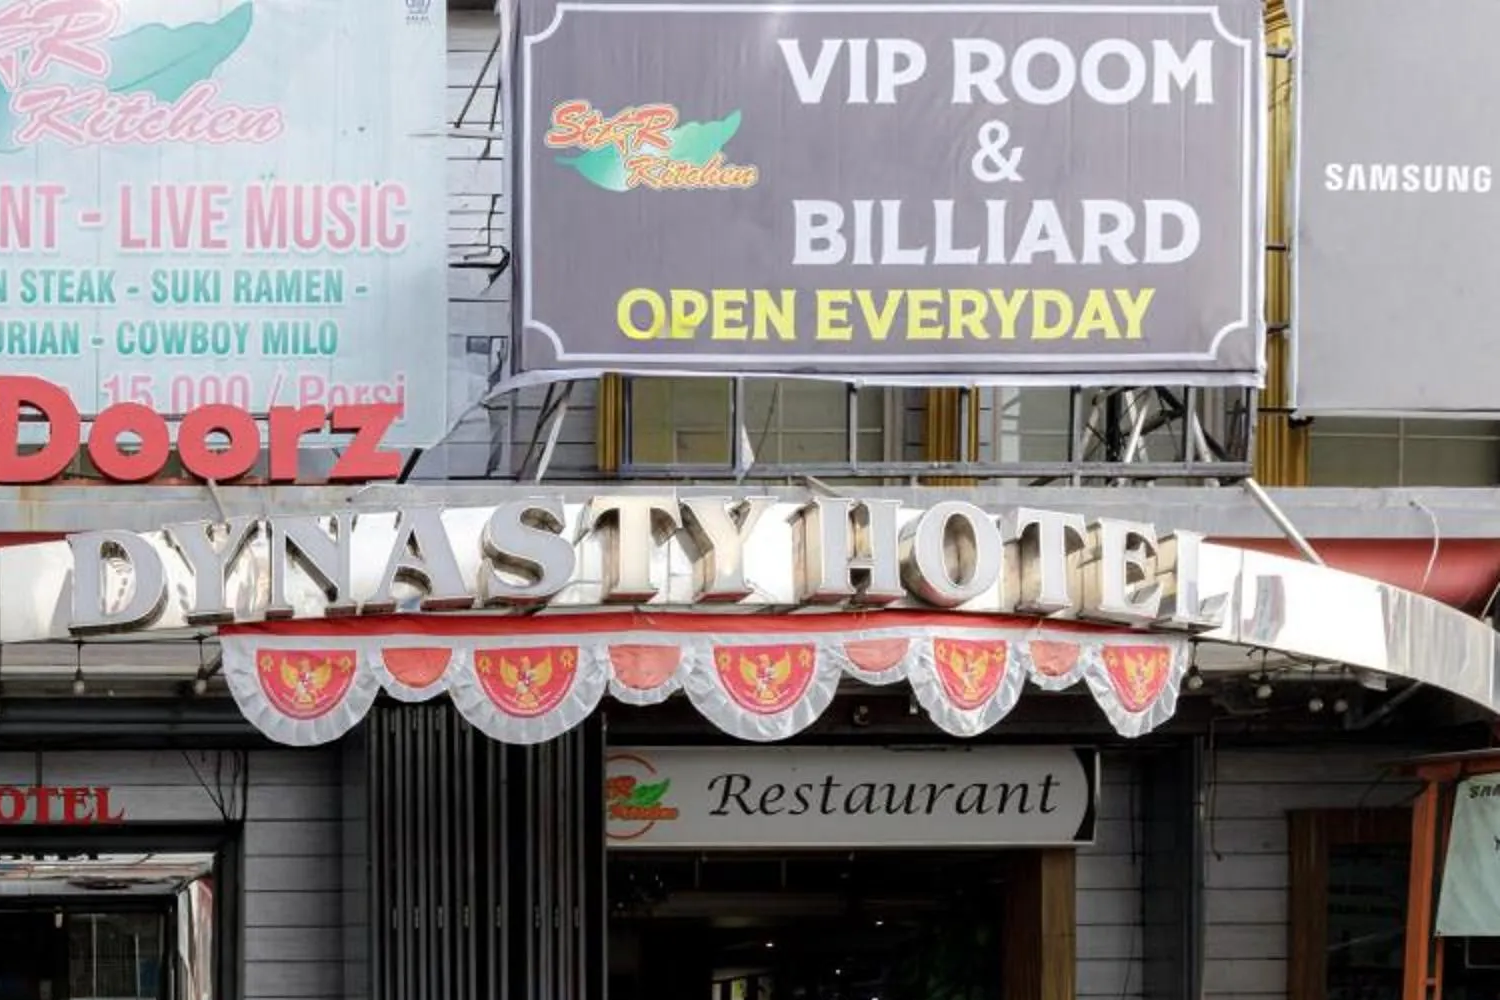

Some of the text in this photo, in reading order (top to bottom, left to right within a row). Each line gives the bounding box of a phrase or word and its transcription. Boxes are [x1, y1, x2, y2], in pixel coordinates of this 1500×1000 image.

[779, 38, 1216, 105] VIP ROOM
[12, 79, 285, 145] Kitchen
[626, 152, 758, 188] Kitchen
[970, 119, 1025, 184] &
[1324, 162, 1493, 194] SAMSUNG
[118, 183, 229, 252] LIVE
[243, 183, 408, 252] MUSIC
[792, 200, 1202, 267] BILLIARD
[19, 268, 117, 305] STEAK
[150, 268, 222, 305] SUKI
[232, 268, 345, 305] RAMEN
[615, 288, 1156, 341] OPEN EVERYDAY
[115, 320, 249, 357] COWBOY
[261, 320, 339, 357] MILO
[66, 494, 1230, 636] DYNASTY HOTEL
[707, 772, 1061, 817] Restaurant
